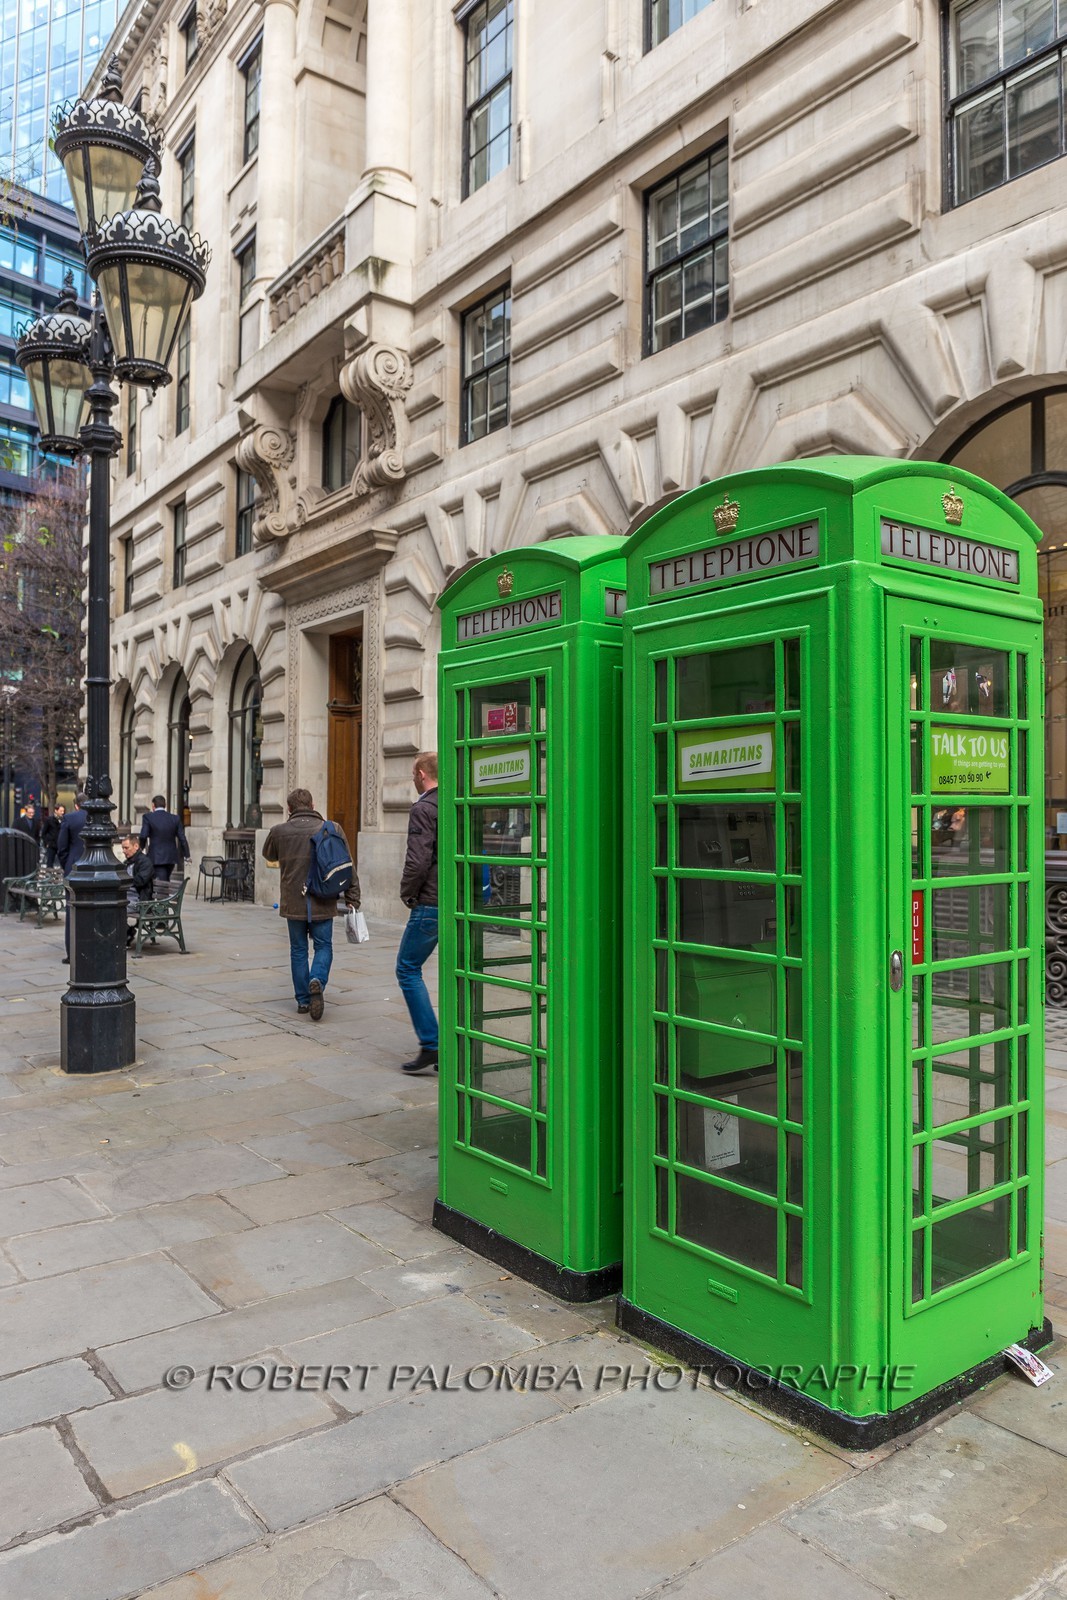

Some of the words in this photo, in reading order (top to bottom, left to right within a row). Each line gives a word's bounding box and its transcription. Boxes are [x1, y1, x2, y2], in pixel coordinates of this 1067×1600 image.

[656, 525, 813, 589] TELEPHONE
[883, 522, 1012, 580] TELEPHONE
[462, 593, 559, 637] TELEPHONE
[689, 744, 763, 769] SAMARITANS
[932, 732, 967, 757] TALK
[969, 735, 987, 757] TO
[990, 737, 1007, 759] US
[479, 758, 525, 777] SAMARITANS
[938, 775, 957, 785] 08457
[958, 774, 966, 784] 90
[968, 773, 975, 782] 90
[976, 772, 984, 782] 90
